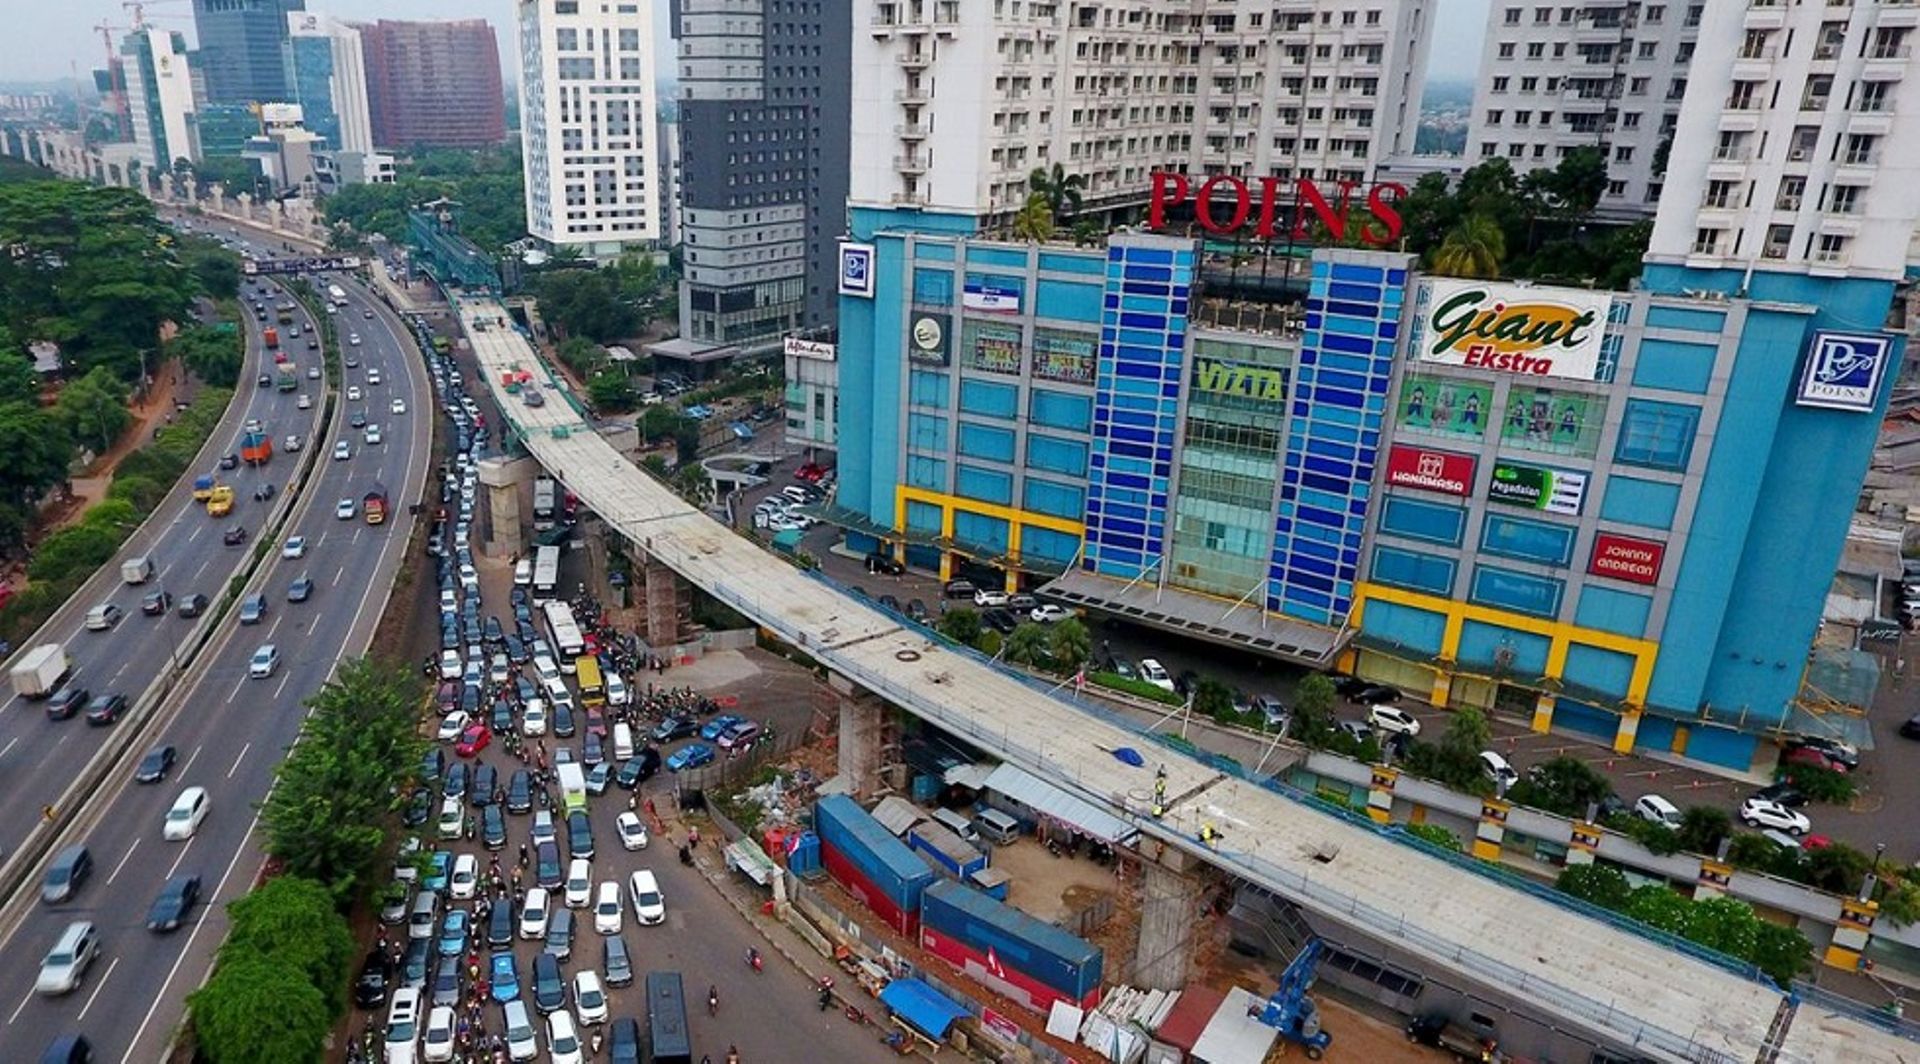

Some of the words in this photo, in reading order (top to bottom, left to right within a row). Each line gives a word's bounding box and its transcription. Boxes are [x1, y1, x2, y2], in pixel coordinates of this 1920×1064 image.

[1148, 171, 1408, 245] POINS
[1432, 290, 1595, 355] Giant
[1463, 345, 1553, 376] Ekstra
[1197, 361, 1282, 400] VIZTA
[1810, 384, 1867, 399] POINS
[1392, 471, 1464, 492] HANAMASA
